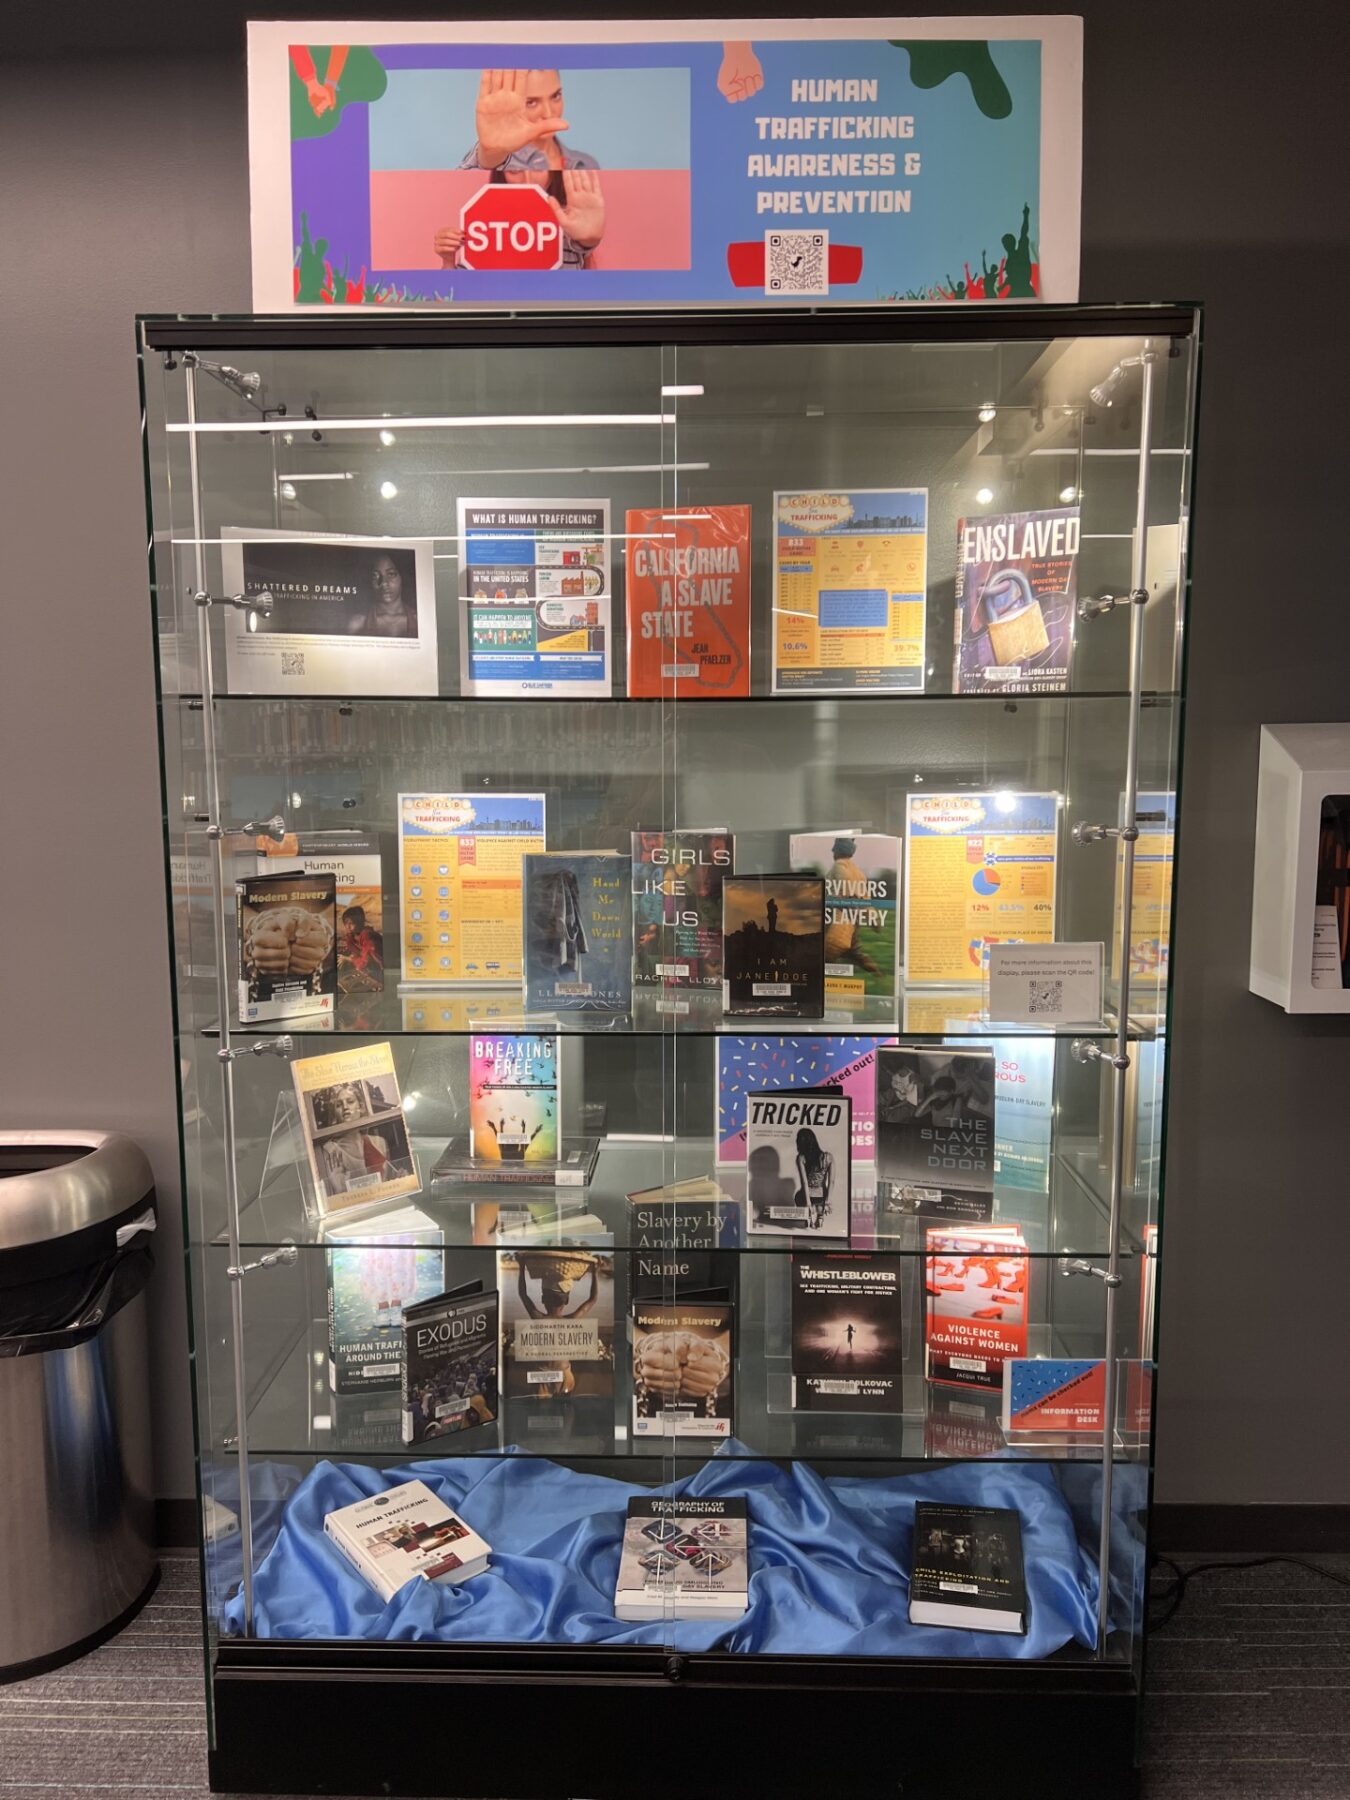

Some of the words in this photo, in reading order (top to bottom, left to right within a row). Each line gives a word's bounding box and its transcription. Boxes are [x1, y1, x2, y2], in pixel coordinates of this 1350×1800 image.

[791, 79, 878, 102] HUMAN
[755, 116, 914, 140] TRAFFICKING
[747, 153, 896, 177] AWARENESS
[904, 153, 921, 176] &
[757, 190, 912, 214] PREVENTION
[467, 220, 556, 252] STOP
[792, 498, 837, 506] CHILD
[472, 513, 495, 524] WHAT
[498, 513, 506, 524] IS
[508, 513, 537, 524] HUMAN
[540, 513, 597, 524] TRAFFICKING?
[790, 514, 838, 522] TRAFFICKING
[964, 517, 1081, 563] ENSLAVED
[635, 546, 740, 577] CALIFORNIA
[480, 575, 490, 583] THE
[491, 575, 510, 583] UNITED
[511, 575, 529, 583] STATES
[247, 582, 309, 592] SHATTERED
[315, 585, 357, 595] DREAMS
[661, 580, 673, 607] A
[678, 578, 733, 606] SLAVE
[273, 592, 310, 600] TRAFFICKING
[319, 594, 344, 602] AMERICA
[641, 611, 694, 639] STATE
[786, 617, 805, 625] 14%
[691, 643, 709, 654] JEAN
[783, 642, 808, 650] 10.6%
[700, 654, 732, 665] PFAELZER
[1002, 683, 1029, 693] GLORIA
[1032, 682, 1067, 692] STEINEM
[651, 848, 731, 866] GIRLS
[304, 861, 344, 870] Human
[593, 878, 620, 888] Hand
[631, 879, 687, 896] LIKE
[825, 880, 887, 898] RVIVORS
[249, 894, 288, 904] Modern
[290, 890, 328, 902] Slavery
[598, 895, 614, 905] Me
[1033, 903, 1052, 911] 40%
[592, 911, 620, 921] Down
[662, 911, 699, 927] US
[825, 908, 888, 927] SLAVERY
[591, 927, 621, 939] World
[635, 974, 682, 983] RACHEL
[736, 972, 769, 981] JANE
[783, 972, 809, 981] DOE
[475, 1041, 551, 1058] BREAKING
[494, 1059, 533, 1075] FREE
[853, 1053, 875, 1072] out!
[1001, 1061, 1018, 1070] SO
[752, 1102, 841, 1126] TRICKED
[946, 1117, 987, 1130] THE
[920, 1129, 987, 1144] SLAVE
[933, 1143, 988, 1157] NEXT
[928, 1156, 986, 1171] DOOR
[637, 1211, 703, 1232] Slavery
[707, 1211, 728, 1232] by
[638, 1233, 712, 1248] Another
[637, 1259, 690, 1276] Name
[800, 1270, 897, 1281] WHISTLEBLOWER
[638, 1316, 679, 1325] Modern
[681, 1317, 722, 1327] Slavery
[417, 1314, 487, 1348] EXODUS
[948, 1324, 1000, 1339] VIOLENCE
[520, 1332, 555, 1346] MODERN
[558, 1332, 593, 1346] SLAVERY
[930, 1333, 974, 1347] AGAINST
[978, 1338, 1019, 1352] WOMEN
[339, 1343, 373, 1353] HUMAN
[944, 1350, 972, 1359] EVERYONE
[345, 1353, 382, 1363] AROUND
[383, 1351, 401, 1360] THE
[956, 1372, 976, 1380] JACQUI
[977, 1375, 992, 1383] TRUE
[356, 1515, 383, 1529] HUMAN
[384, 1498, 429, 1518] TRAFFICKING
[915, 1573, 963, 1583] TRAFFICKING
[939, 1570, 992, 1582] EXPLOITATION
